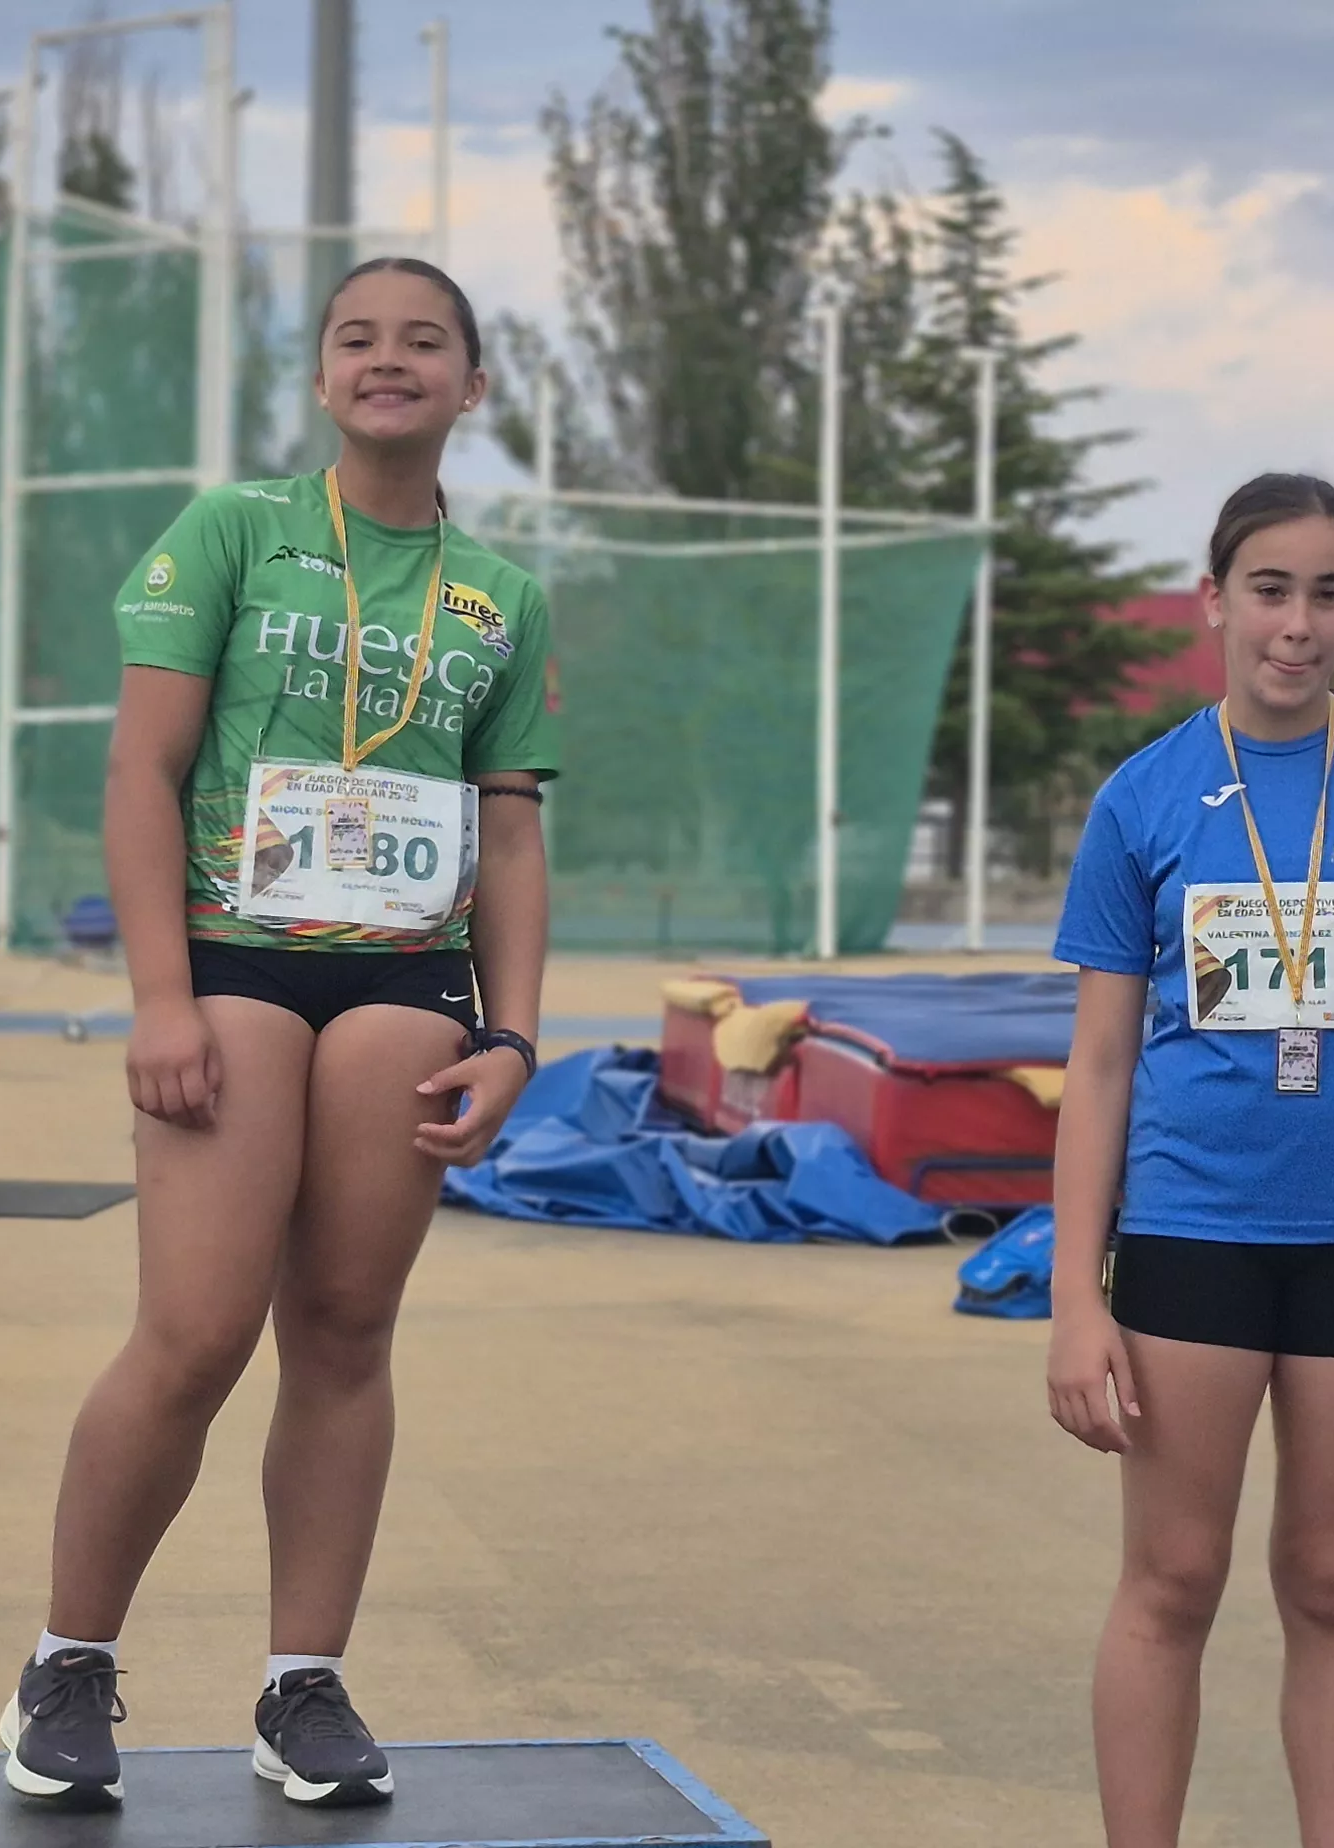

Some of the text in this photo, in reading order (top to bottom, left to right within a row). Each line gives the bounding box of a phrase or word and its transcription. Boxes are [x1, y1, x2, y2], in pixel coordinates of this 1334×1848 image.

[255, 611, 494, 710] Huesca
[282, 664, 330, 700] La
[286, 781, 302, 791] EN
[304, 782, 334, 794] EDAD
[351, 778, 420, 793] DEPORTIVOS
[270, 804, 314, 816] NICOLE
[288, 825, 439, 881] 180
